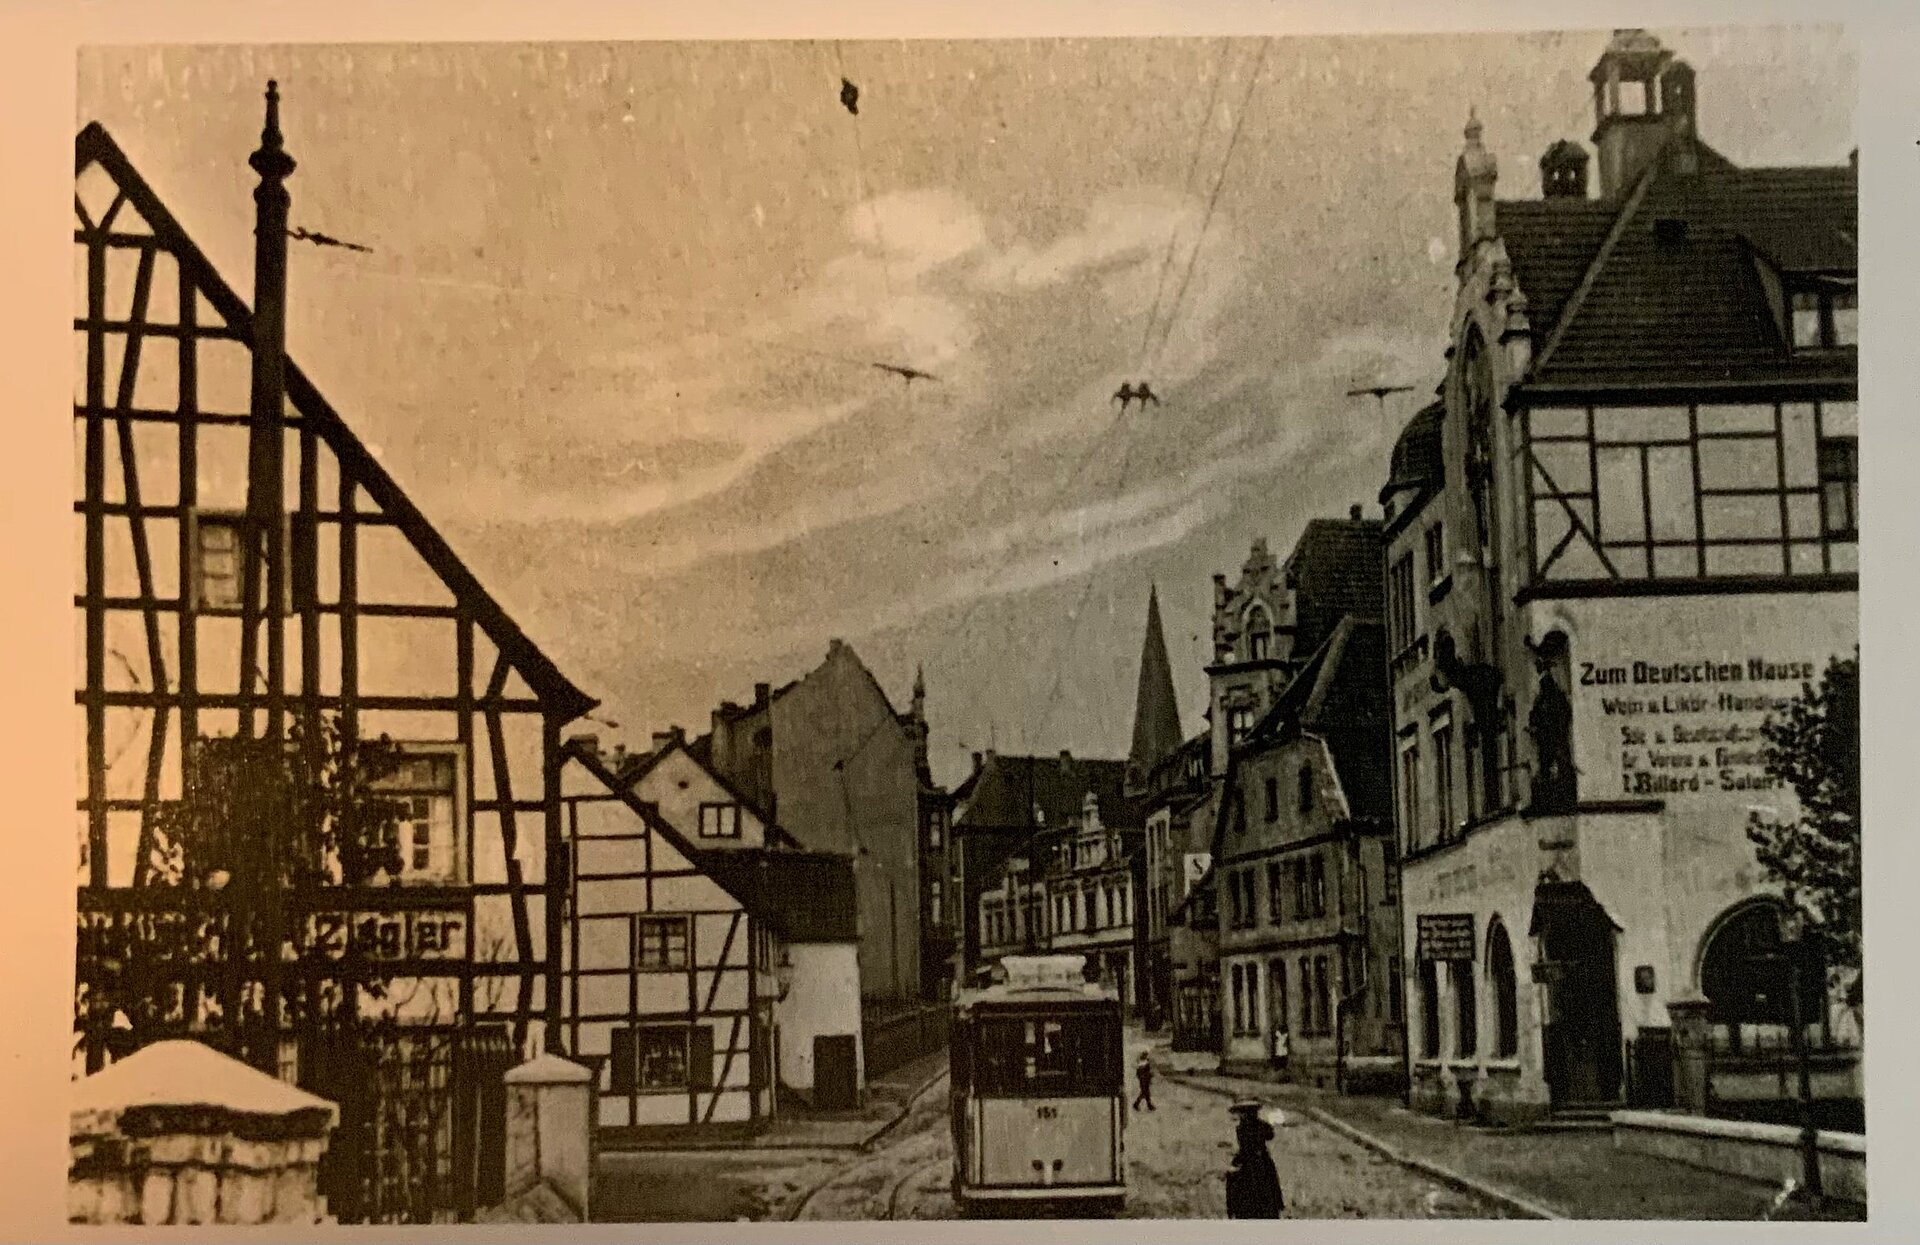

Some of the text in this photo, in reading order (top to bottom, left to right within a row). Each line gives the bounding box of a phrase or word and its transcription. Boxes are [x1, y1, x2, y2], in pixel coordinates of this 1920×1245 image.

[1580, 658, 1814, 685] Zum Deutschen Hause
